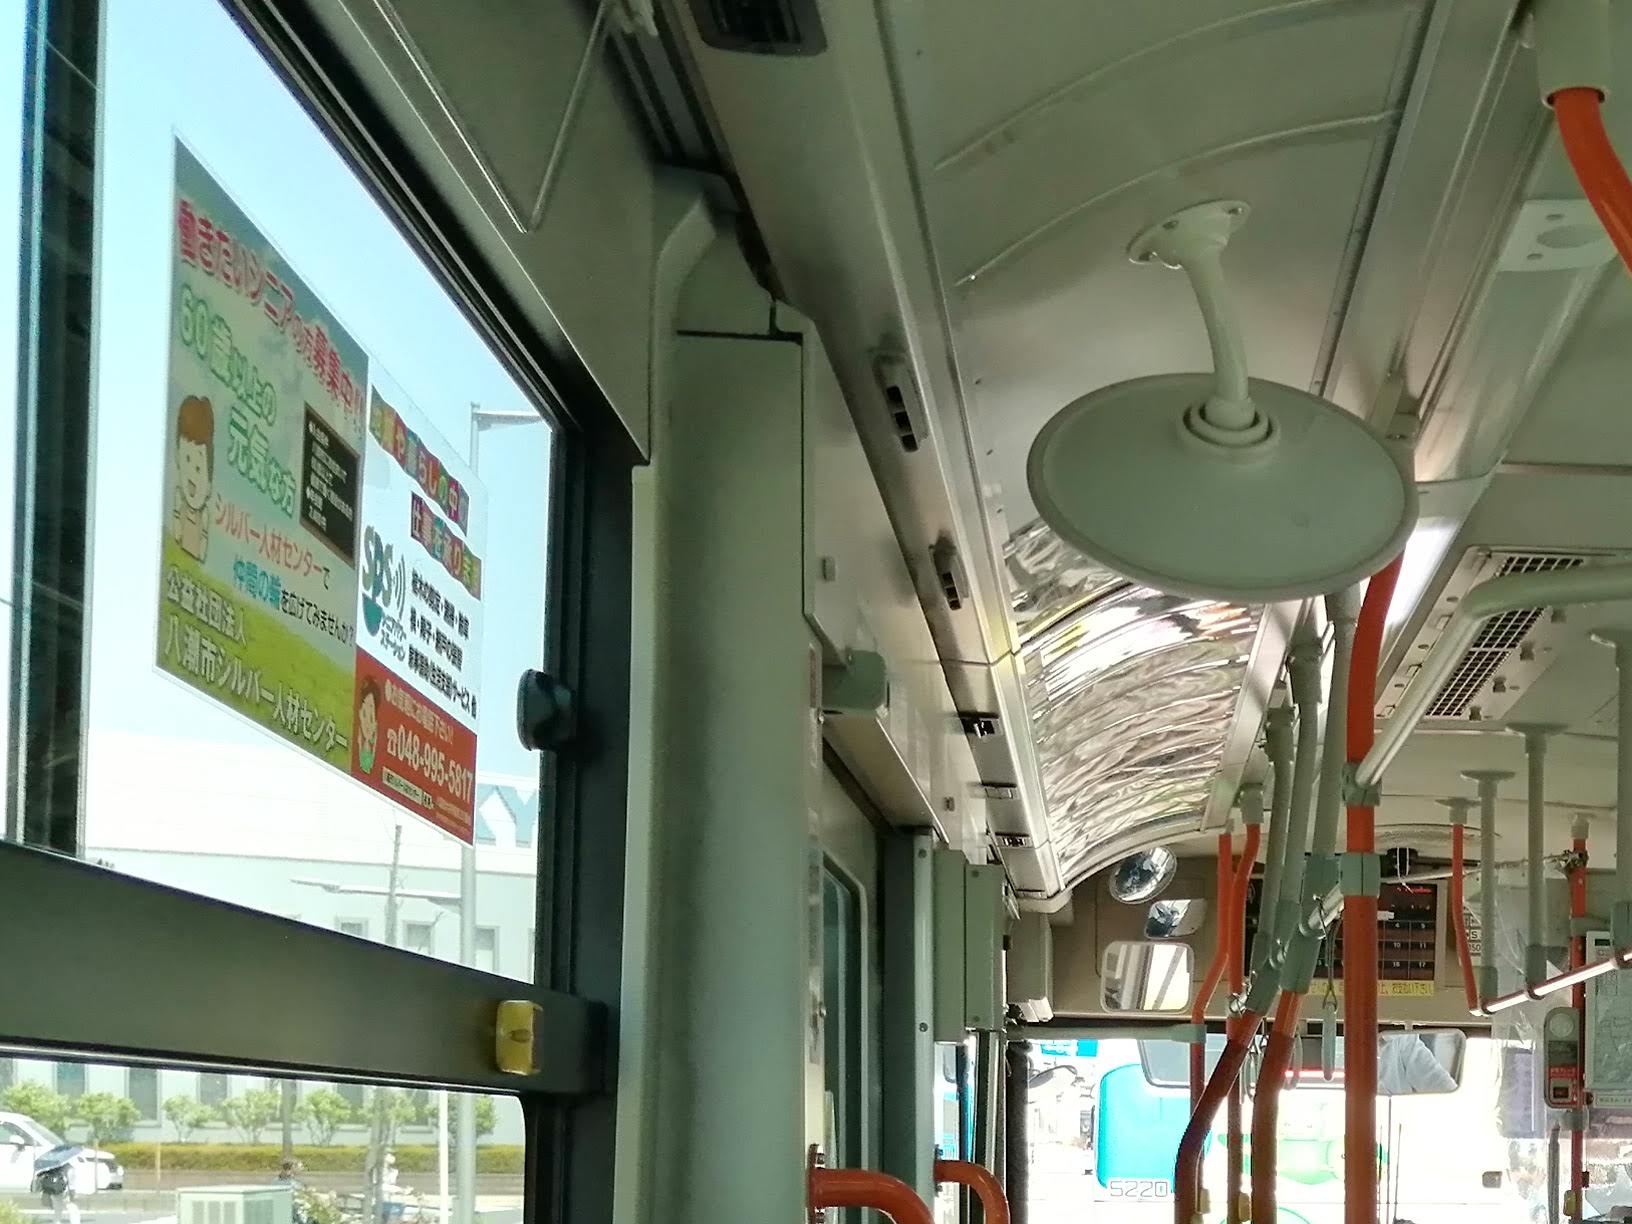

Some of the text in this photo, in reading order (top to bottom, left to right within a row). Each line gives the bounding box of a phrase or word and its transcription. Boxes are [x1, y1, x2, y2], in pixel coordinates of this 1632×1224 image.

[214, 492, 331, 591] シルバー人材センターで
[165, 563, 248, 648] 公益社団法人
[165, 614, 348, 752] 八潮市シルバー人材センター
[398, 724, 474, 804] 048-995-5817
[1110, 1181, 1168, 1197] 5220
